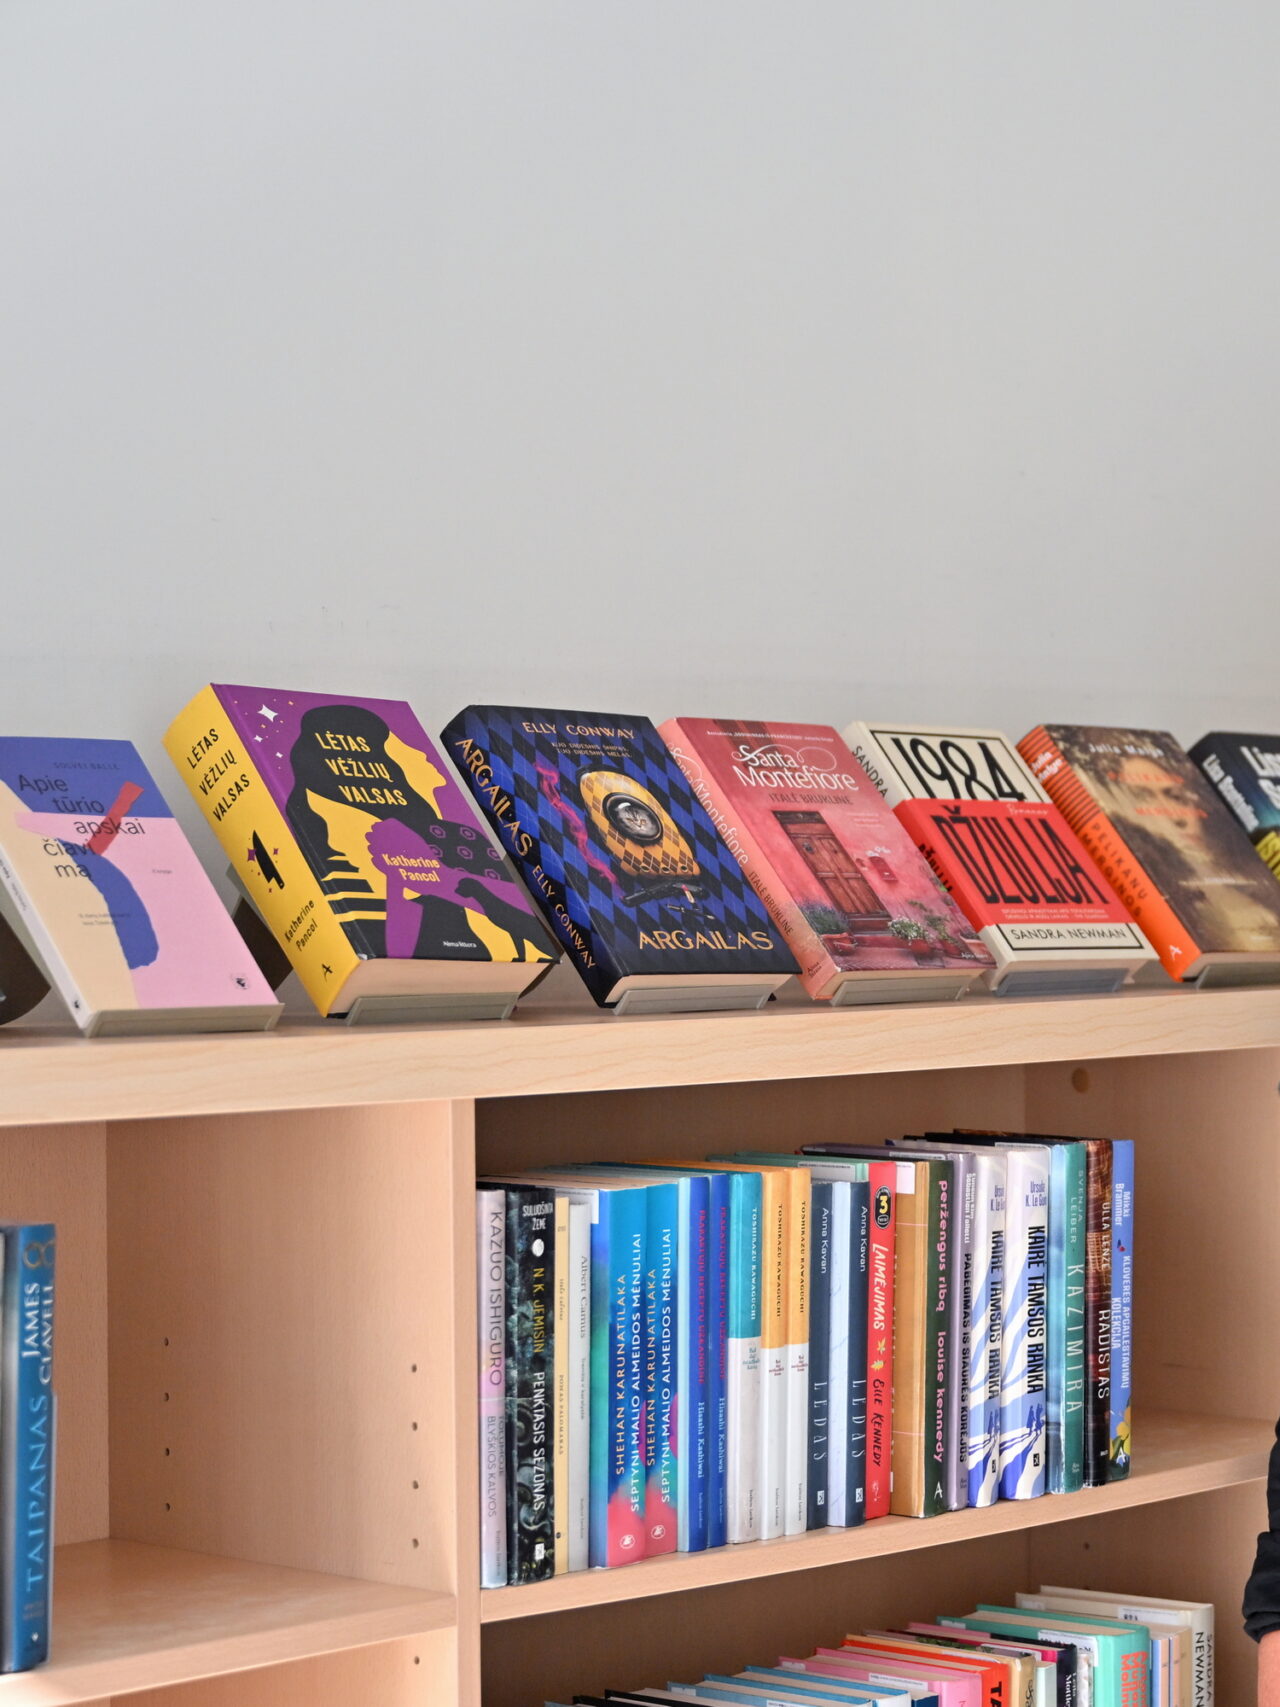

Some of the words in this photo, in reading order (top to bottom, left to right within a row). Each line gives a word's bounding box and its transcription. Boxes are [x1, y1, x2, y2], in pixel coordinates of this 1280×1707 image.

[187, 728, 219, 769] LĖTAS
[315, 731, 371, 752] LĖTAS
[522, 722, 557, 734] ELLY
[566, 724, 637, 740] CONWAY
[731, 744, 805, 769] Santa
[18, 774, 69, 795] Apie
[199, 749, 237, 796] VĖŽLIŲ
[325, 757, 394, 782] VĖŽLIŲ
[732, 765, 860, 791] Montefiore
[852, 745, 890, 798] SANDRA
[891, 736, 1027, 801] 1984
[52, 796, 105, 814] tūrio
[213, 773, 250, 821] VALSAS
[338, 785, 408, 806] VALSAS
[43, 838, 97, 857] čiavi
[73, 817, 146, 838] apskai
[692, 782, 749, 866] Montefiore
[381, 853, 441, 869] Katherine
[398, 868, 441, 883] Pancol
[284, 900, 316, 943] Katherine
[532, 864, 556, 899] ELLY
[555, 903, 597, 970] CONWAY
[749, 871, 769, 897] ITALĖ
[763, 894, 794, 938] BRUKLINE
[295, 918, 319, 952] Pancol
[1011, 928, 1064, 940] SANDRA
[1069, 929, 1127, 940] NEWMAN
[821, 1207, 829, 1237] Anna
[860, 1206, 868, 1235] Anna
[936, 1180, 949, 1271] peržengus
[1069, 1197, 1077, 1244] LEIBER
[1101, 1202, 1110, 1230] ULLA
[1114, 1183, 1124, 1226] Brammer
[1122, 1191, 1131, 1217] Mikki
[490, 1211, 503, 1282] KAZUO
[630, 1234, 641, 1307] MĖNULIAI
[661, 1228, 671, 1300] MĖNULIAI
[820, 1240, 829, 1274] Kavan
[860, 1238, 868, 1272] Kavan
[1027, 1226, 1047, 1269] KAIRĖ
[1101, 1235, 1110, 1271] LENZE
[580, 1256, 588, 1291] Albert
[872, 1243, 889, 1331] LAIMĖJIMAS
[935, 1276, 948, 1312] ribą
[21, 1282, 41, 1359] JAMES
[533, 1299, 546, 1353] JEMISIN
[580, 1297, 588, 1339] Camus
[647, 1269, 656, 1393] KARUNATILAKA
[989, 1280, 1004, 1343] TAMSOS
[1027, 1274, 1046, 1338] TAMSOS
[1110, 1297, 1122, 1349] KOLEKCIJA
[489, 1288, 503, 1386] ISHIGURO
[616, 1274, 627, 1399] KARUNATILAKA
[631, 1313, 641, 1391] ALMEIDOS
[662, 1306, 671, 1383] ALMEIDOS
[936, 1331, 946, 1383] louise
[1066, 1263, 1084, 1413] KAZIMIRA
[1098, 1309, 1111, 1399] RADISTAS
[988, 1348, 1001, 1400] RANKA
[1026, 1343, 1044, 1394] RANKA
[533, 1371, 546, 1444] PENKTASIS
[631, 1396, 641, 1445] MALIO
[647, 1400, 656, 1467] SHEHAN
[661, 1388, 671, 1437] MALIO
[813, 1382, 828, 1461] LEDAS
[852, 1380, 866, 1458] LEDAS
[934, 1387, 946, 1463] kennedy
[487, 1416, 500, 1471] BLYŠKIOS
[616, 1407, 626, 1475] SHEHAN
[870, 1412, 884, 1468] KENNEDY
[26, 1395, 49, 1593] TAIPANAS
[487, 1472, 498, 1518] KALVOS
[533, 1449, 546, 1511] SEZONAS
[631, 1449, 641, 1512] SEPTYNI
[661, 1442, 671, 1503] SEPTYNI
